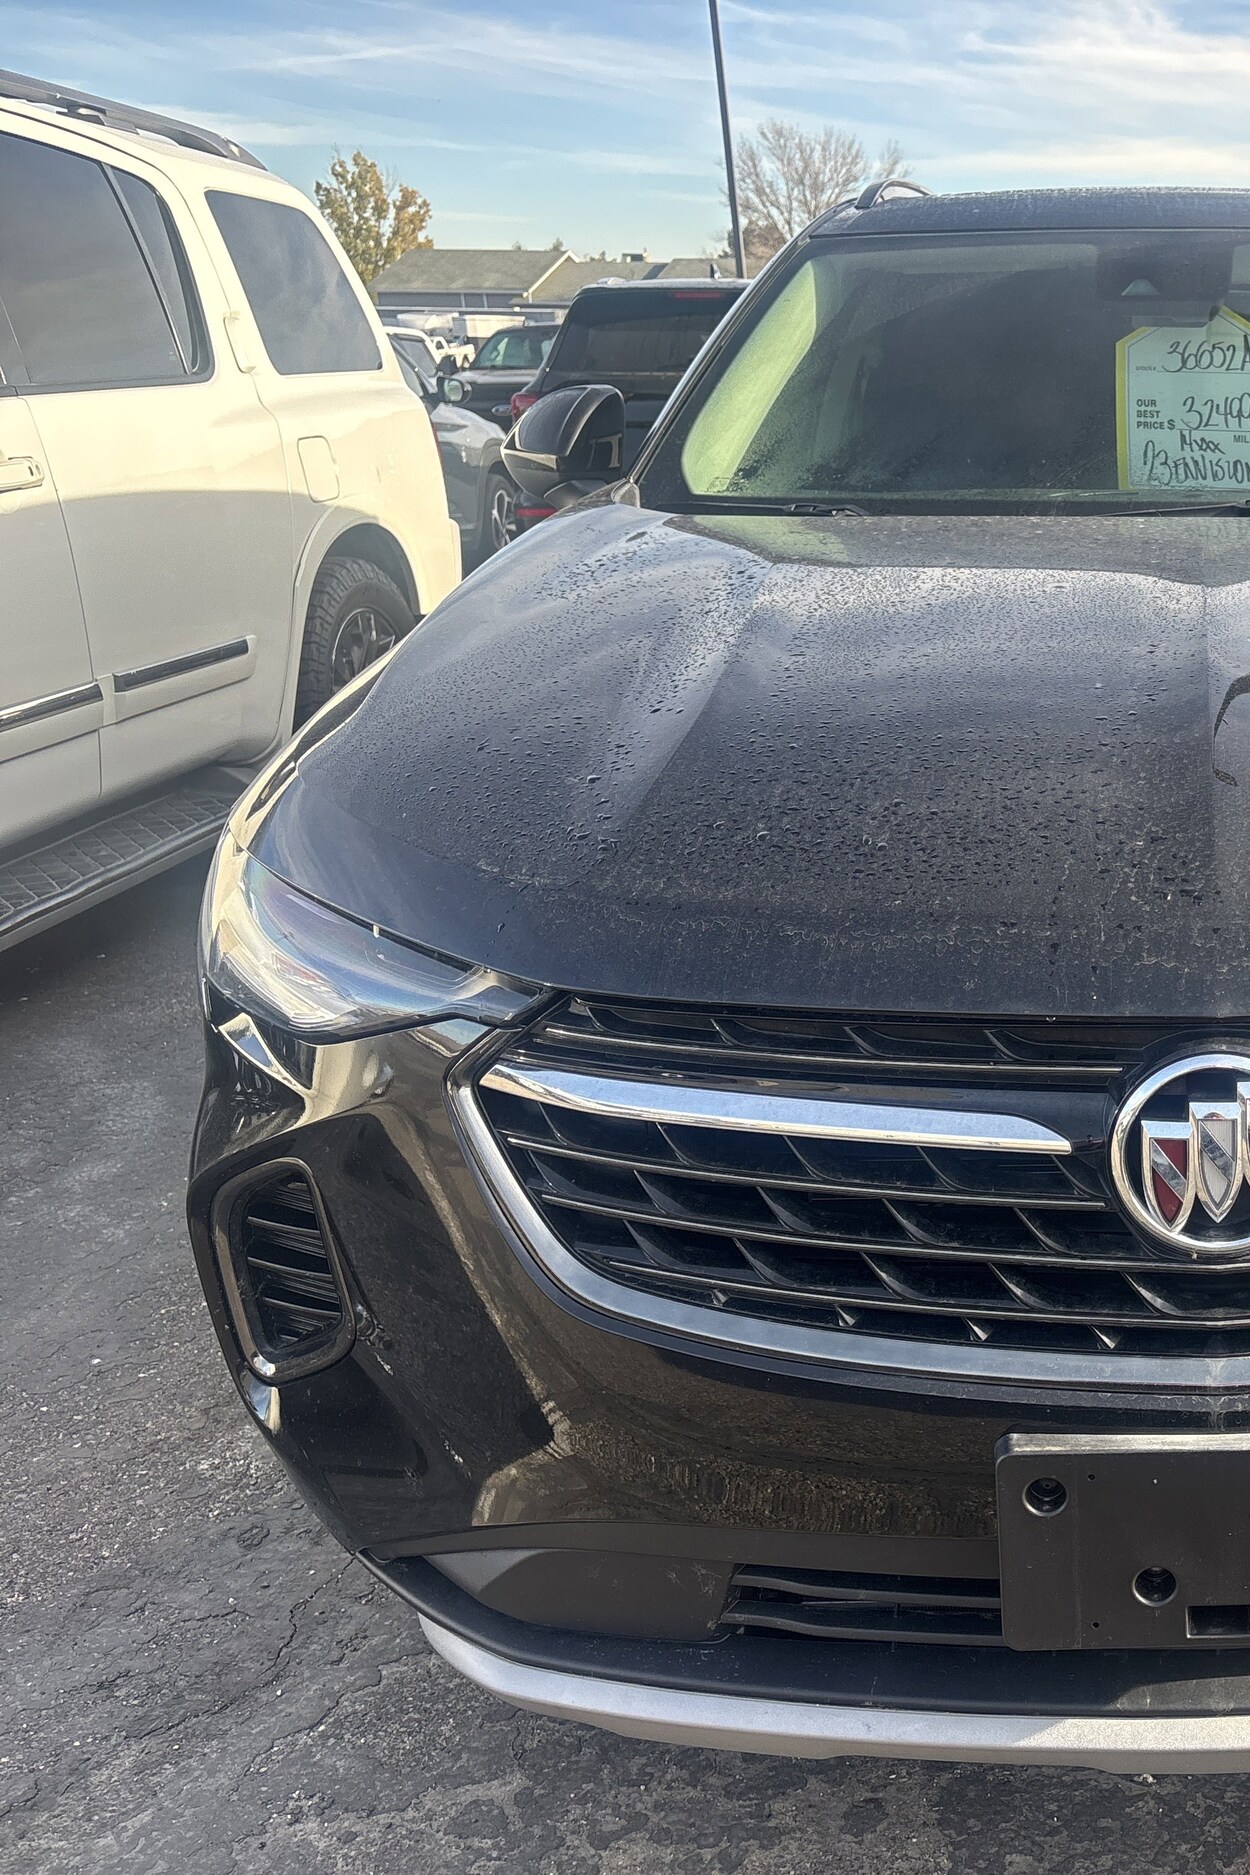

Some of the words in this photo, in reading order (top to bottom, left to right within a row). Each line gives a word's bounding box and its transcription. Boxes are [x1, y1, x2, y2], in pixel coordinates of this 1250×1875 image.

[1136, 399, 1157, 408] OUR
[1136, 410, 1160, 419] BEST
[1136, 421, 1165, 430] PRICE
